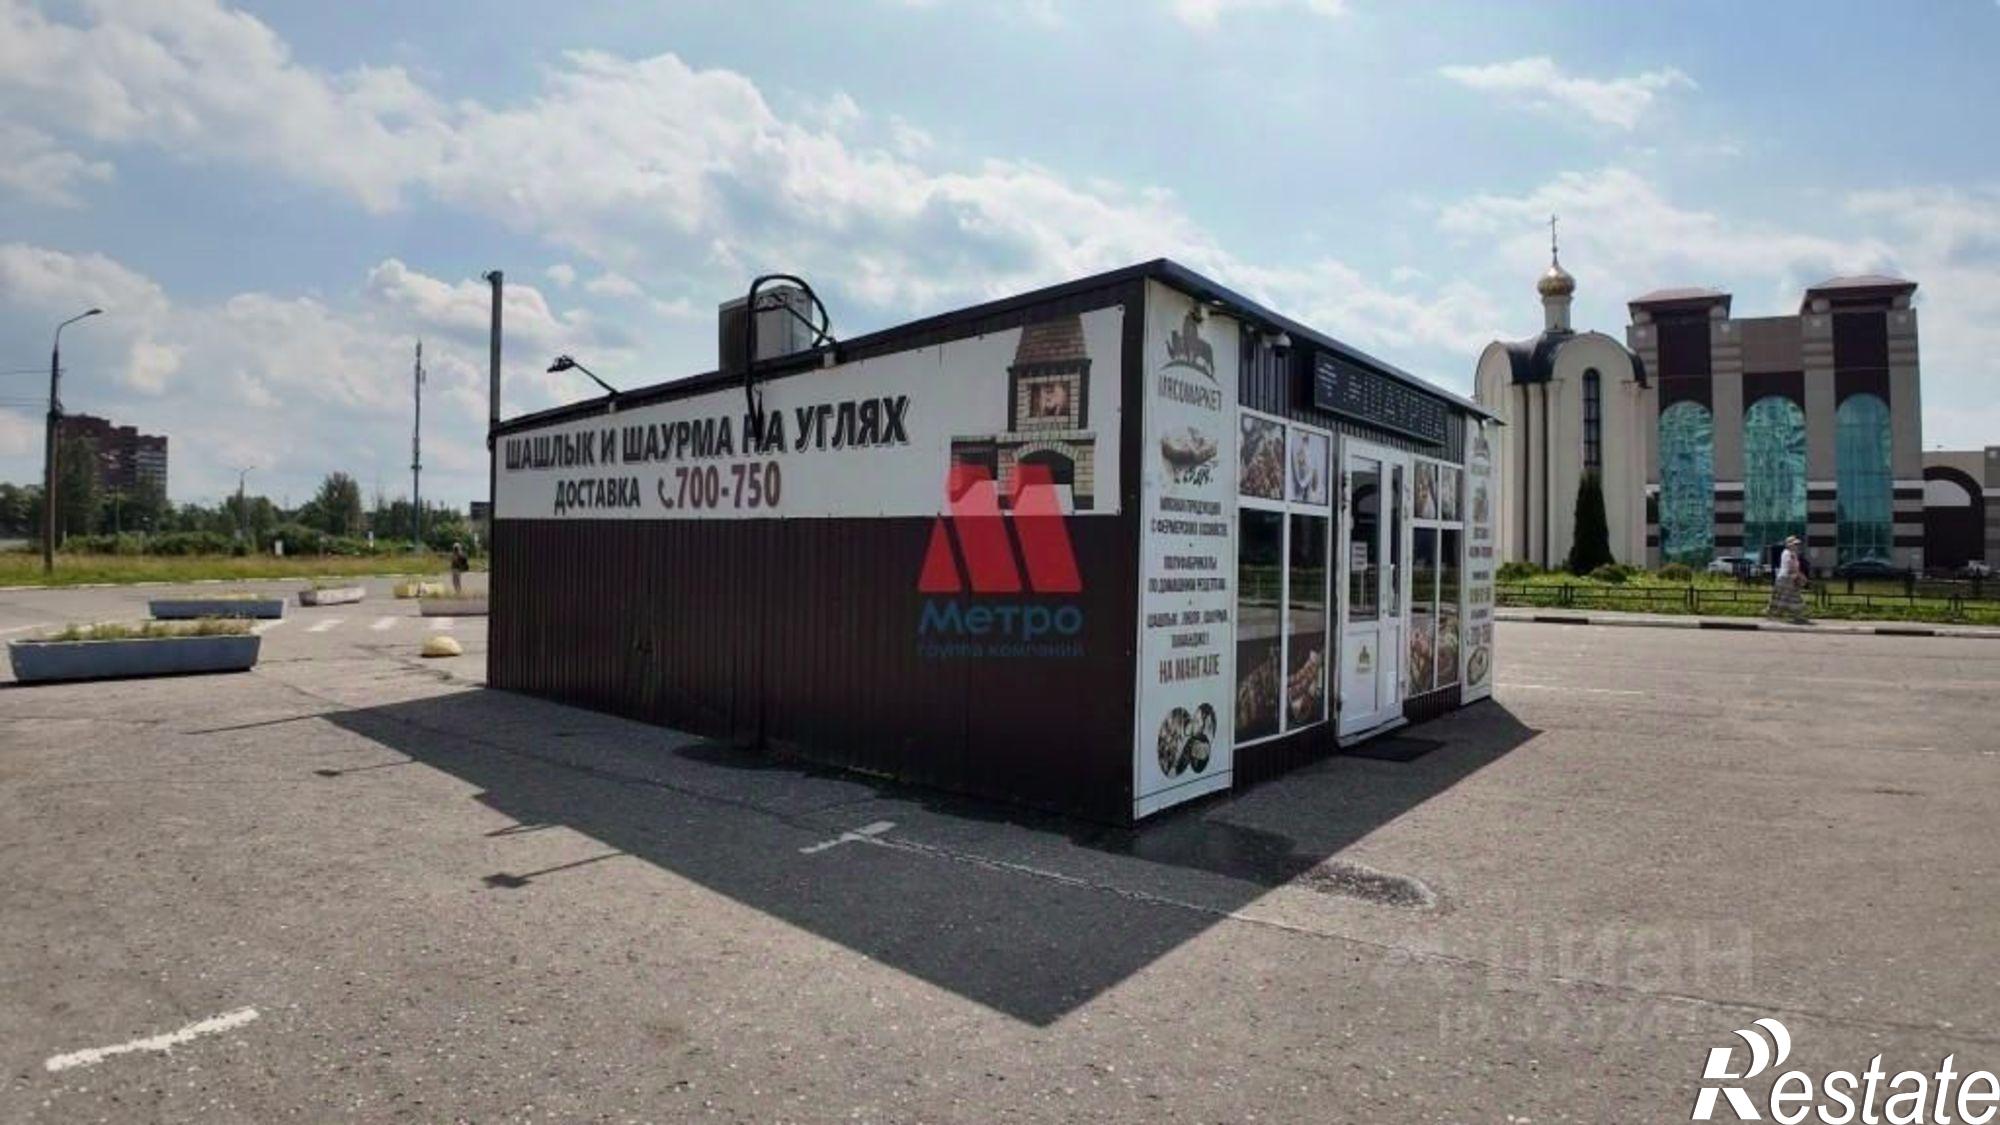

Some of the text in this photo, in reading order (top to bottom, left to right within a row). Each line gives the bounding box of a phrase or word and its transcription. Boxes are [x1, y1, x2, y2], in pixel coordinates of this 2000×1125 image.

[505, 395, 911, 471] ШАШЛЫК И ШАУРМА НА УГЛЯХ
[553, 460, 782, 515] ДОСТАВКА 700-750
